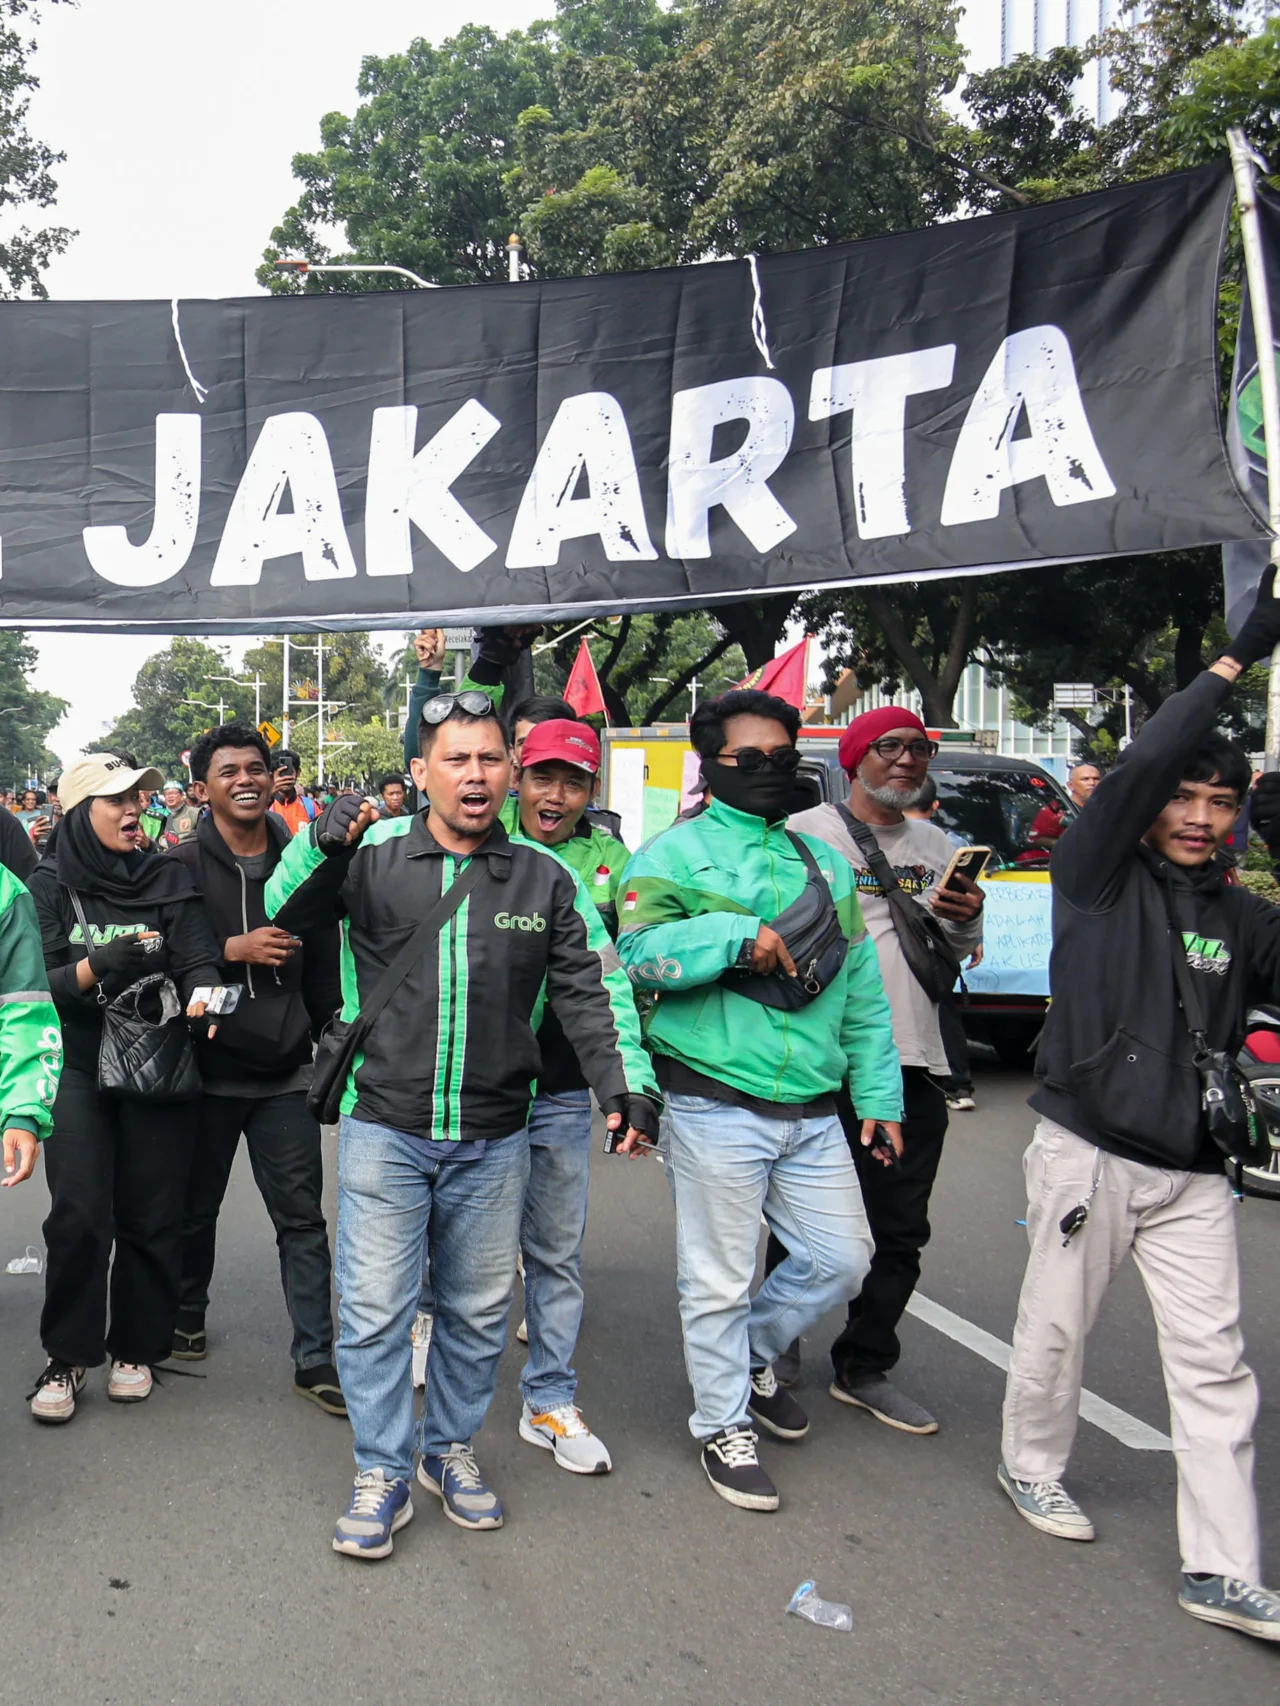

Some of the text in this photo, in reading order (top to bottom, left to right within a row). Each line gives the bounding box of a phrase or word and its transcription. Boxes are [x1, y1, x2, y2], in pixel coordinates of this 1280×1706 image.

[82, 324, 1117, 588] JAKARTA
[494, 911, 547, 933] Grab
[625, 952, 682, 985] rab
[981, 952, 1046, 969] AKUS
[36, 1026, 63, 1106] Grab
